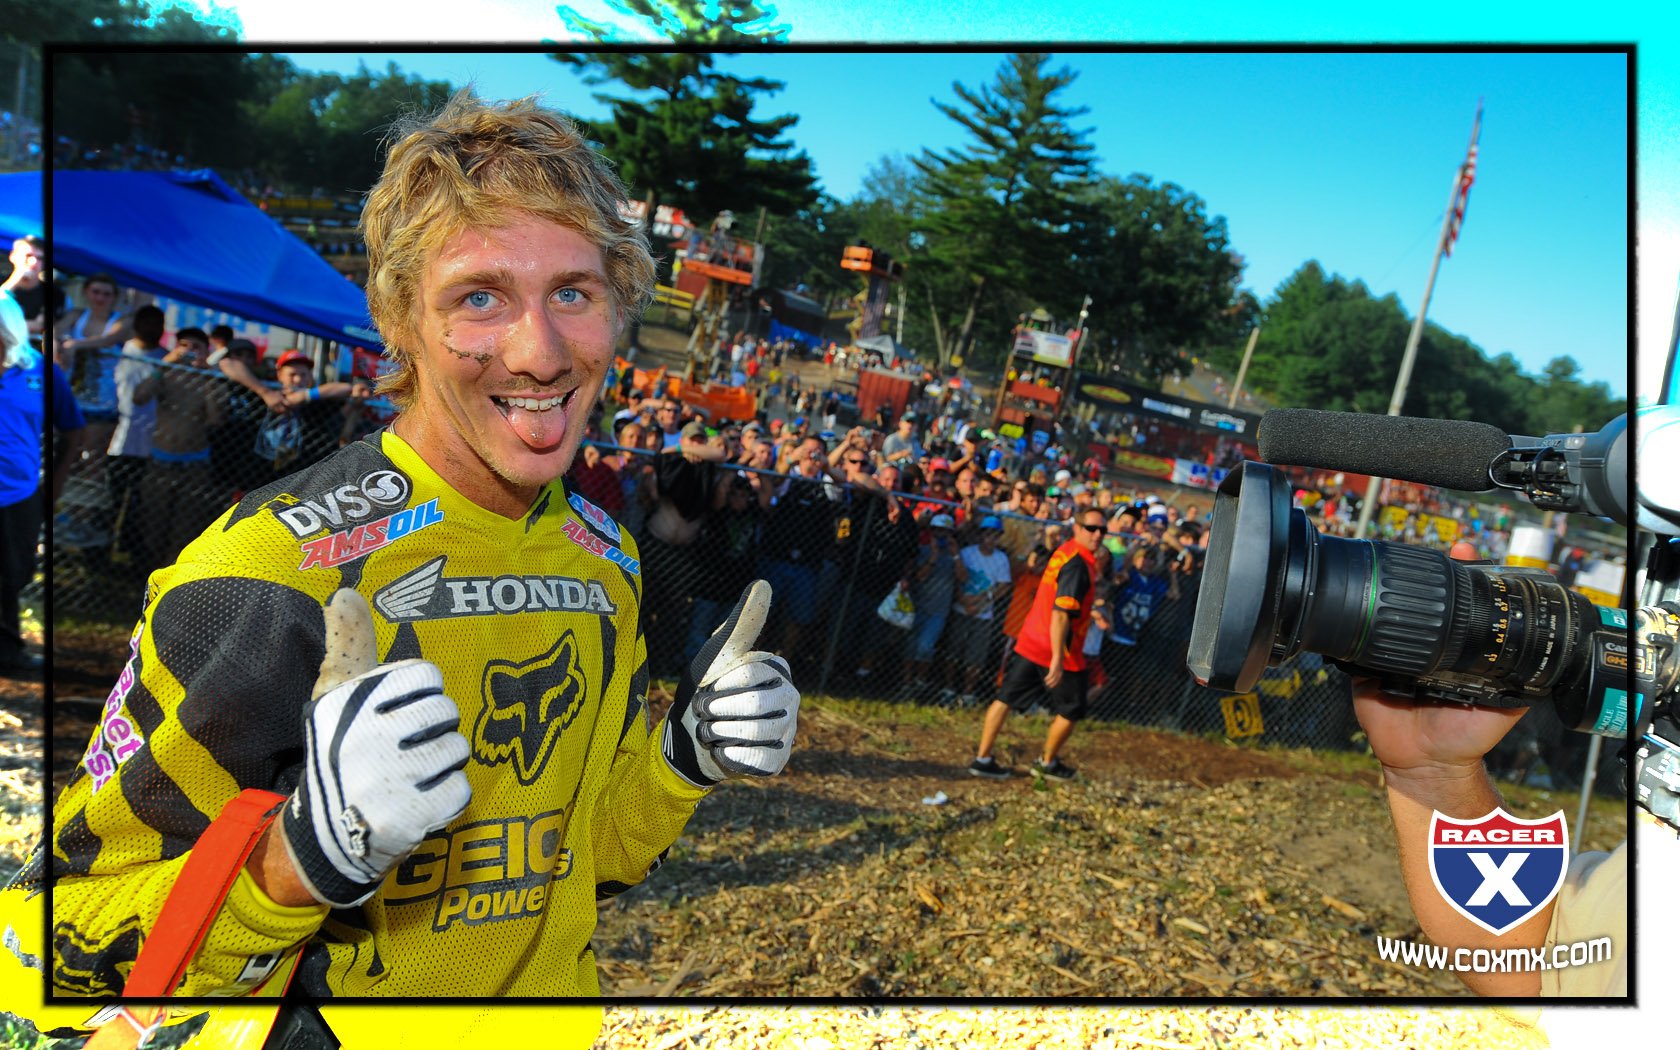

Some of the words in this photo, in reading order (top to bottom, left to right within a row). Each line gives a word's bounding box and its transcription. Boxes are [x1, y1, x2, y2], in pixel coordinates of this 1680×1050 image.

[278, 484, 371, 537] DVS
[298, 496, 444, 570] AMSOIL
[560, 516, 641, 575] AMSOIL
[445, 577, 614, 614] HONDA
[383, 813, 564, 900] GEIC
